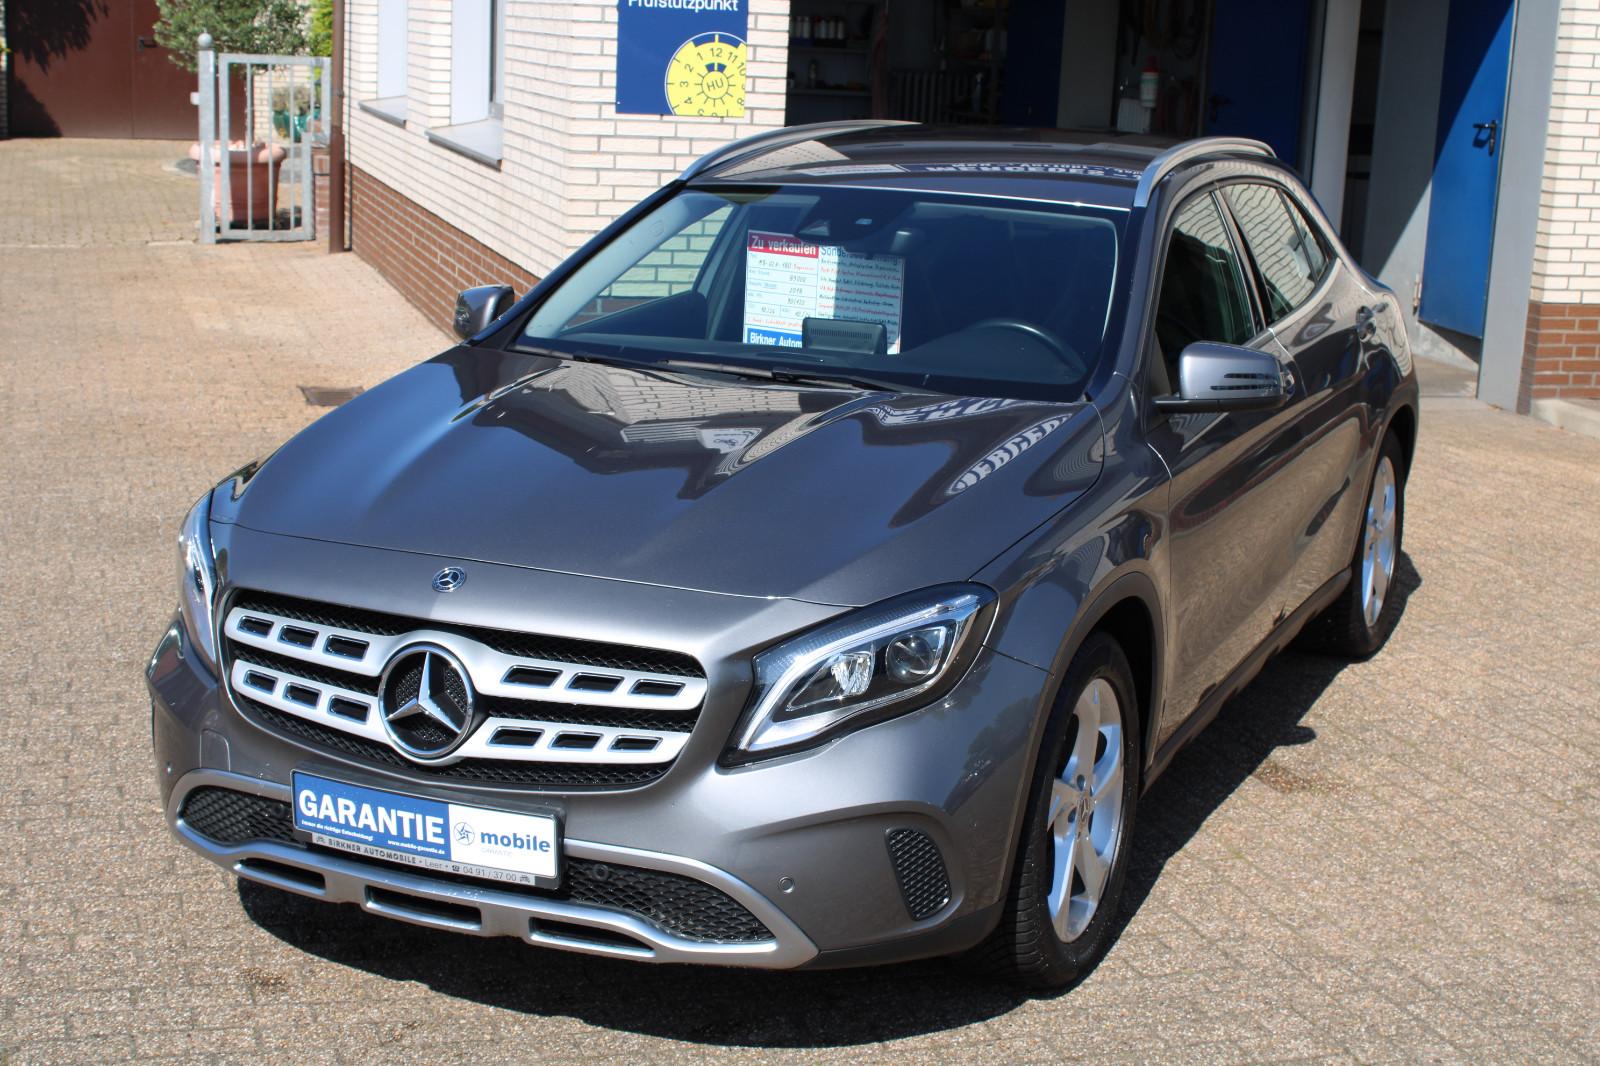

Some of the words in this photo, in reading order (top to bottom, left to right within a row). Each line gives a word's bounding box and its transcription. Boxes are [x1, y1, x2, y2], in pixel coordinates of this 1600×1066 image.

[696, 52, 704, 60] 1
[709, 47, 723, 58] 12
[727, 52, 738, 64] 11
[684, 63, 694, 73] 2
[679, 80, 689, 88] 3
[706, 78, 724, 92] HU
[751, 235, 764, 250] Zu
[768, 239, 816, 255] verkaufen
[750, 331, 776, 346] Birkner
[299, 789, 445, 845] GARANTIE
[480, 831, 551, 853] mobile
[328, 838, 361, 852] BIRKNER
[364, 847, 417, 864] AUTOMOBILE
